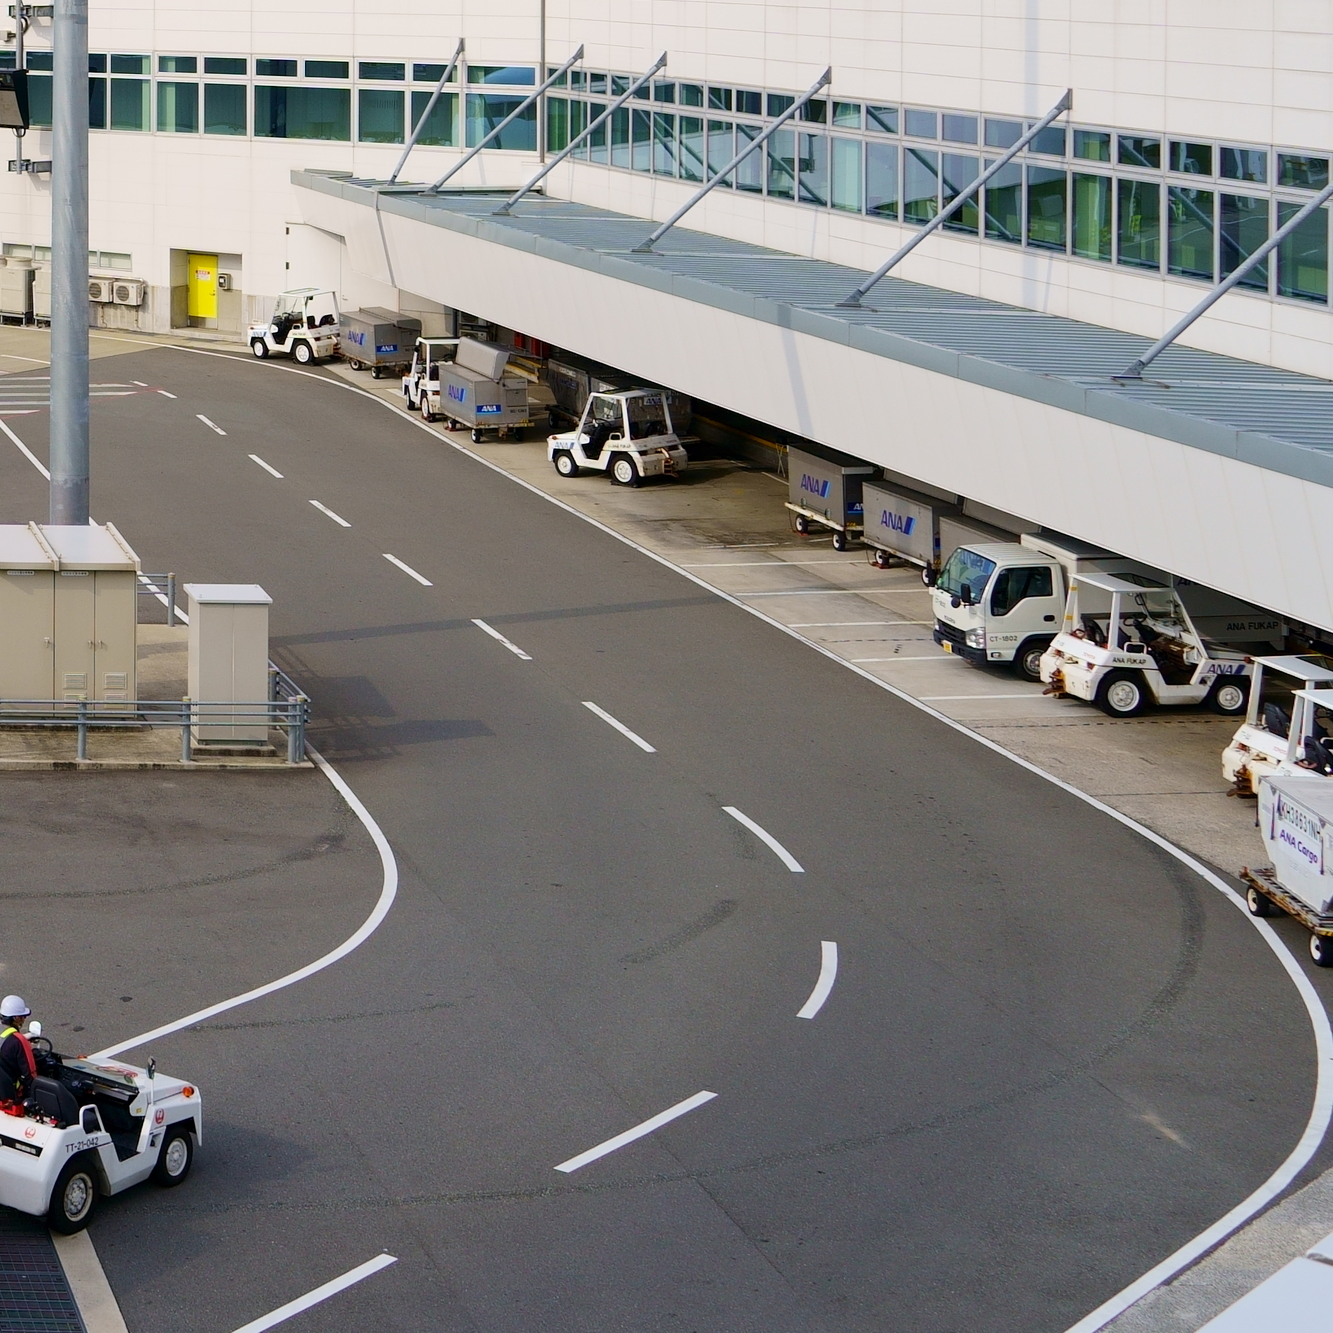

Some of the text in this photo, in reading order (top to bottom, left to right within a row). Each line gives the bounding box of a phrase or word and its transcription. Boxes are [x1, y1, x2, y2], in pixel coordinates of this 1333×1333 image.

[347, 330, 359, 345] ANA
[448, 384, 459, 401] ANA
[800, 474, 820, 495] ANA
[853, 503, 864, 511] AN
[881, 509, 903, 534] ANA
[1226, 621, 1279, 631] ANA FUKAP
[1126, 657, 1148, 665] FUKAP
[1207, 663, 1233, 675] ANA
[1280, 829, 1318, 864] ANA Cargo
[65, 1137, 99, 1153] TT-21-042
